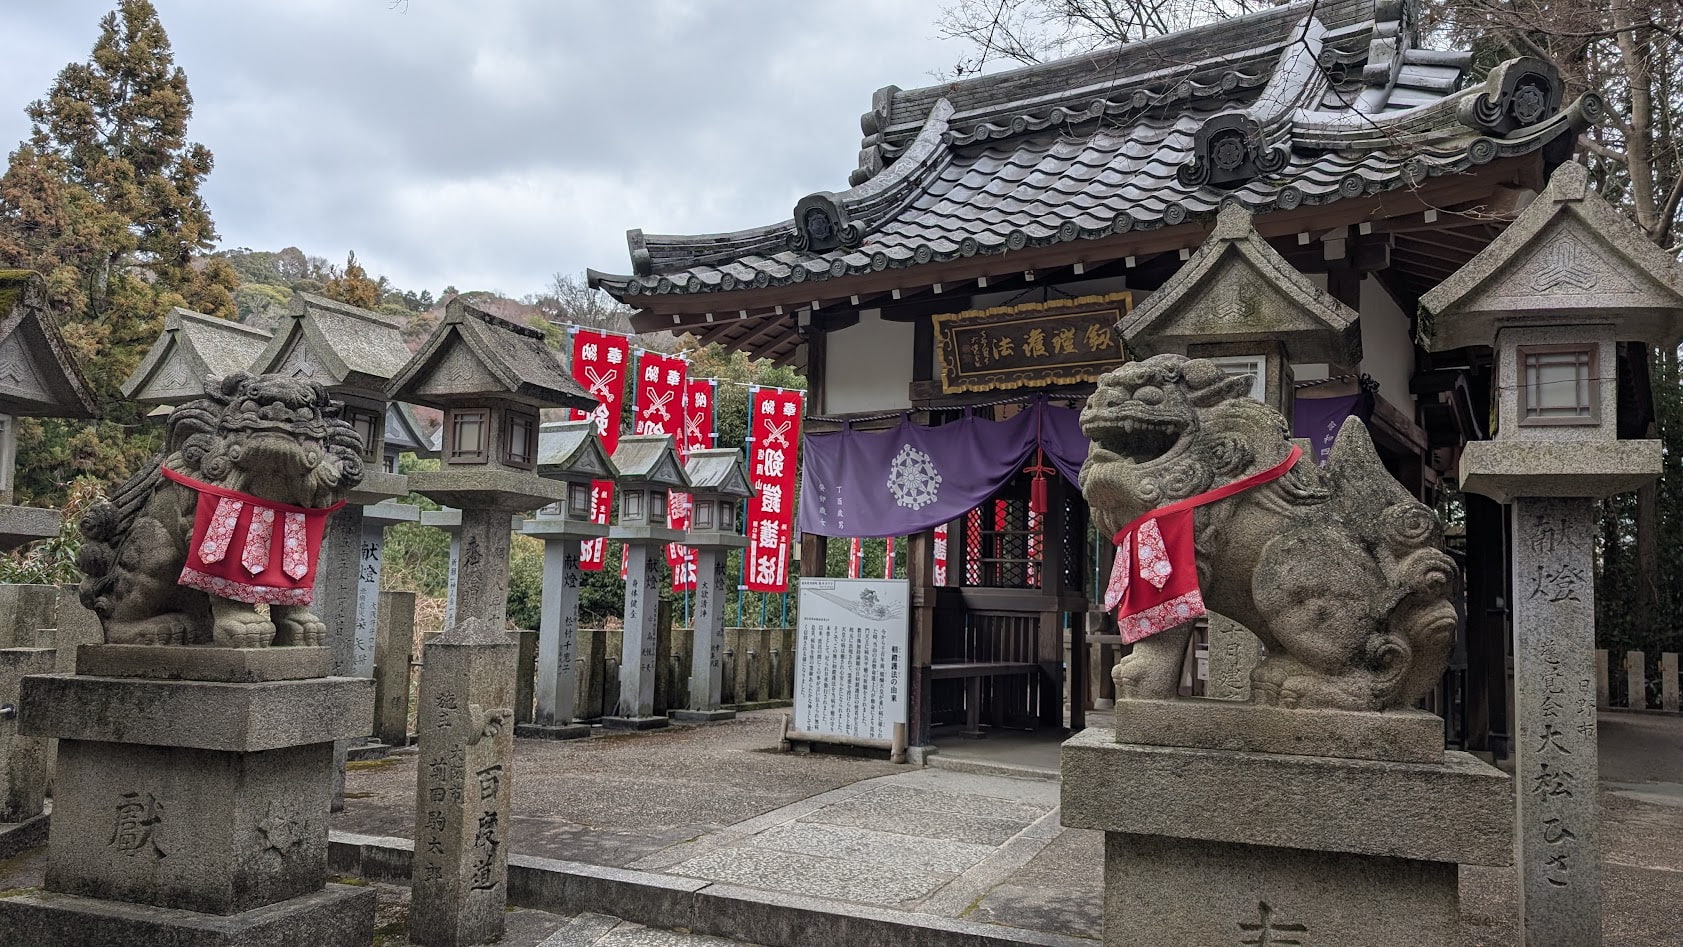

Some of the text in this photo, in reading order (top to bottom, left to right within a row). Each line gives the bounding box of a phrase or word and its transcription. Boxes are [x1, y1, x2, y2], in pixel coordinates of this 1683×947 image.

[358, 541, 380, 583] 献燈
[563, 552, 580, 589] 献燈
[645, 556, 659, 591] 献燈
[1528, 515, 1588, 604] 献燈
